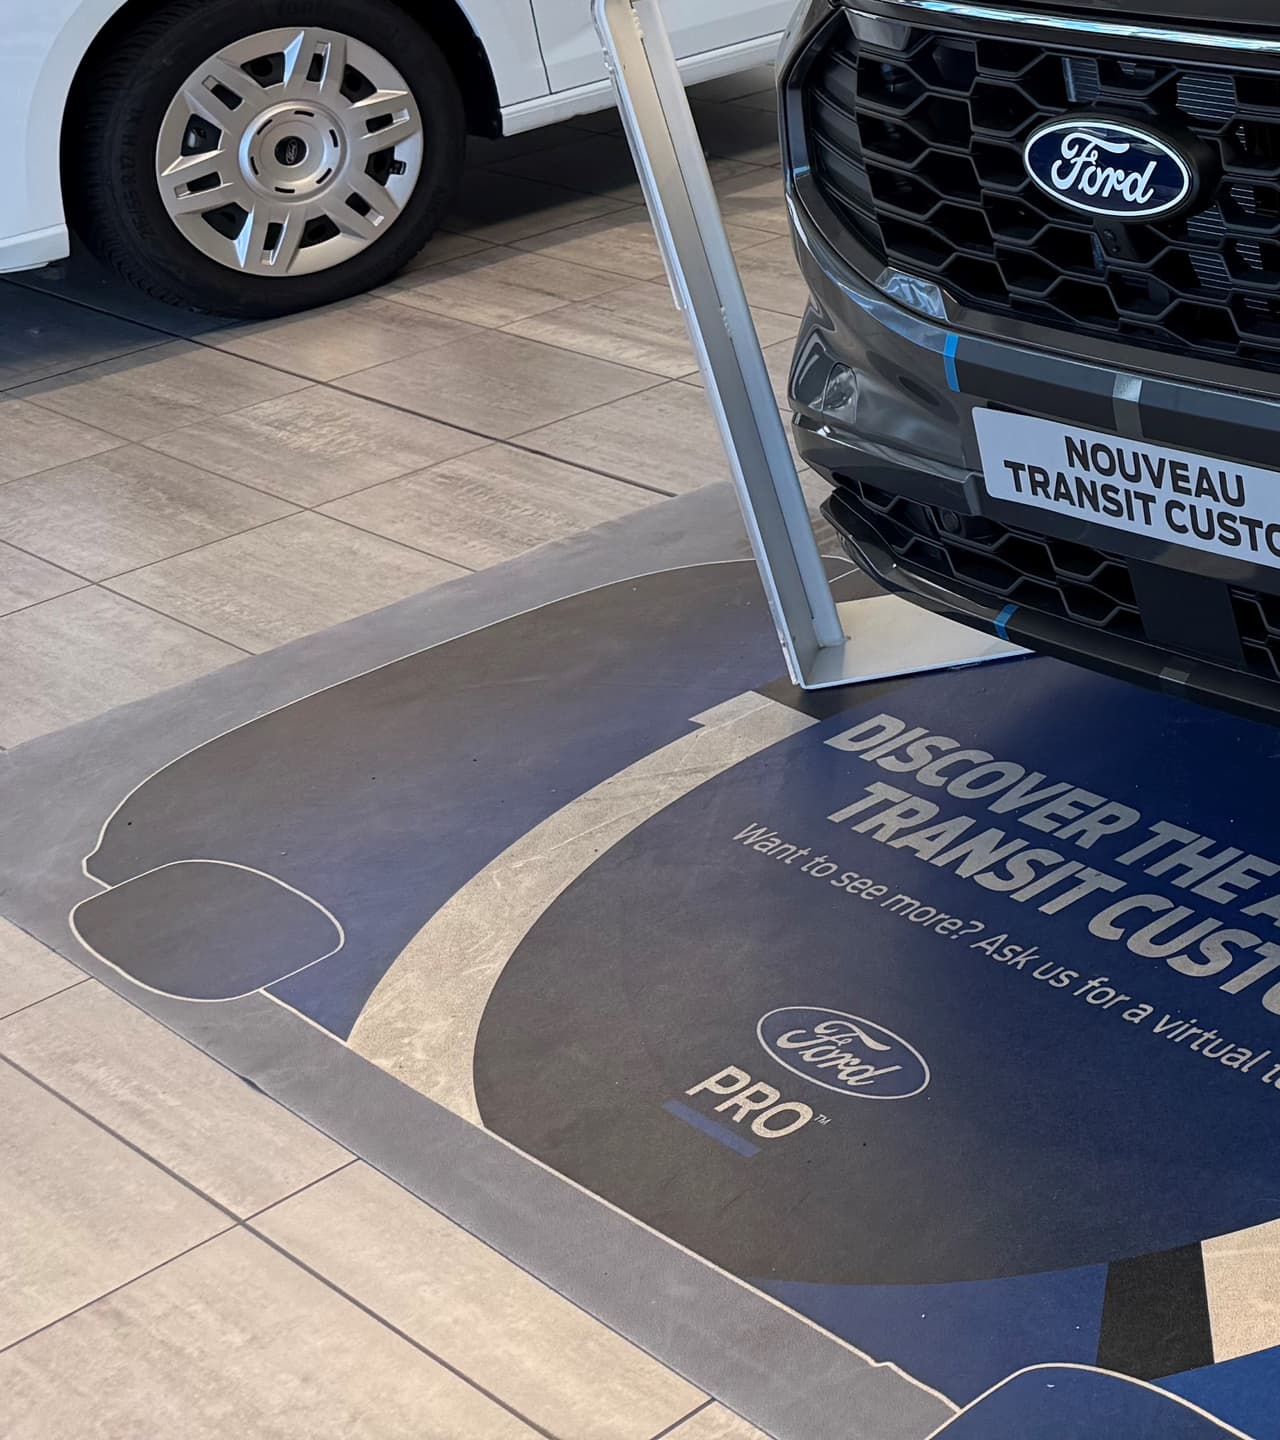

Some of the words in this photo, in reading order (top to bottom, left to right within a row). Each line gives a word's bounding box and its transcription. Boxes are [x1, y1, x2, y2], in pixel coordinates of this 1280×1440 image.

[1051, 131, 1157, 205] Ford
[1003, 460, 1156, 525] TRANSIT
[1064, 436, 1246, 507] NOUVEAU
[824, 713, 1141, 849] DISCOVER
[827, 781, 1127, 916] TRANSIT
[732, 822, 809, 864] Want
[801, 854, 839, 878] to
[830, 870, 888, 901] see
[880, 893, 985, 940] more?
[970, 934, 1040, 971] Ask
[1032, 961, 1080, 988] us
[1073, 976, 1131, 1009] for
[1122, 1003, 1154, 1024] a
[1152, 1014, 1272, 1073] virtual
[776, 1020, 903, 1087] Ford
